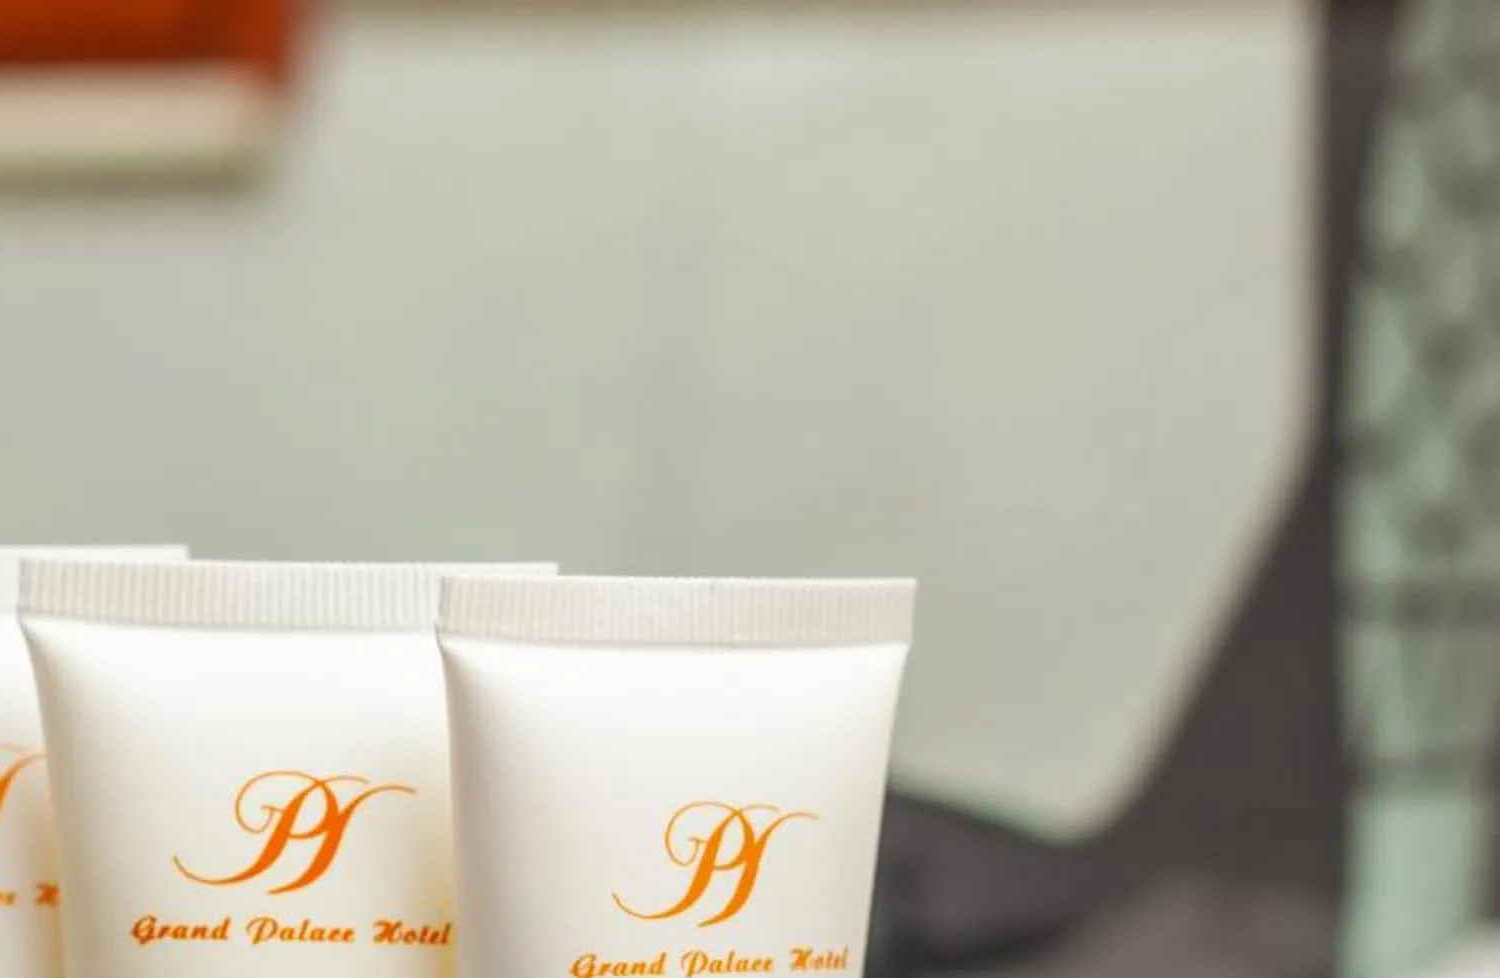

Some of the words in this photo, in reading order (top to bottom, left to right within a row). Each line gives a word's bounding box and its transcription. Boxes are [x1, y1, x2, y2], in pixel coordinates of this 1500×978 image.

[130, 914, 231, 948] Grand
[246, 915, 356, 945] Palace
[373, 918, 454, 948] Hotel
[679, 948, 774, 978] Palace
[789, 945, 849, 972] Hotel
